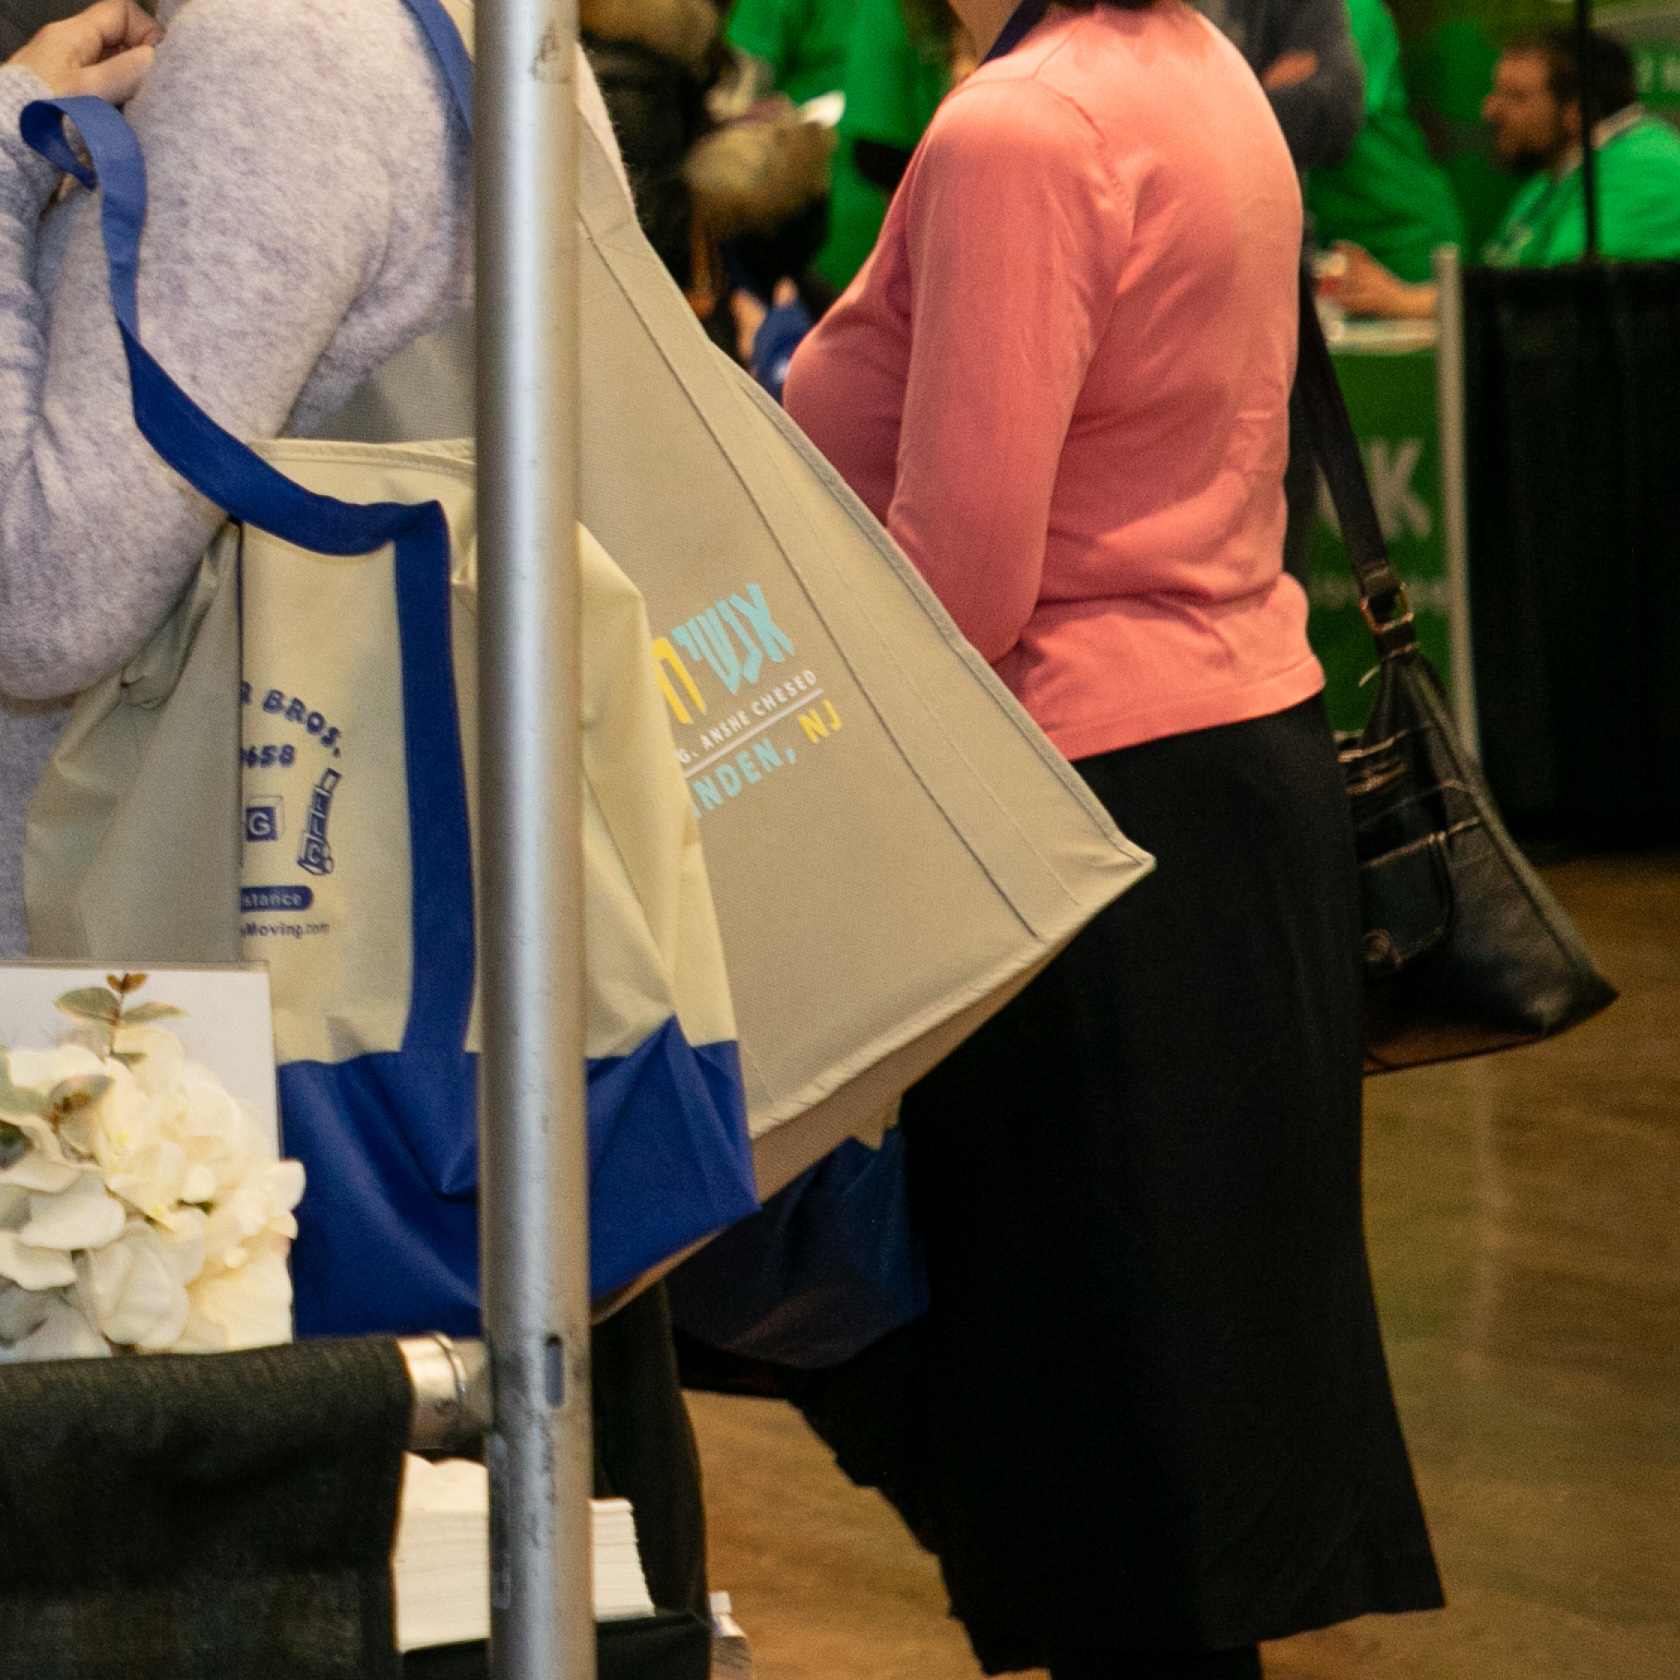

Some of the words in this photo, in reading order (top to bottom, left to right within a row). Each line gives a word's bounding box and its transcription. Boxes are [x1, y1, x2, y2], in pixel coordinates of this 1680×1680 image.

[262, 688, 342, 759] BROS.
[699, 709, 752, 751] ANSHE
[751, 669, 818, 717] CHESED
[796, 699, 842, 745] NJ
[248, 812, 271, 836] G
